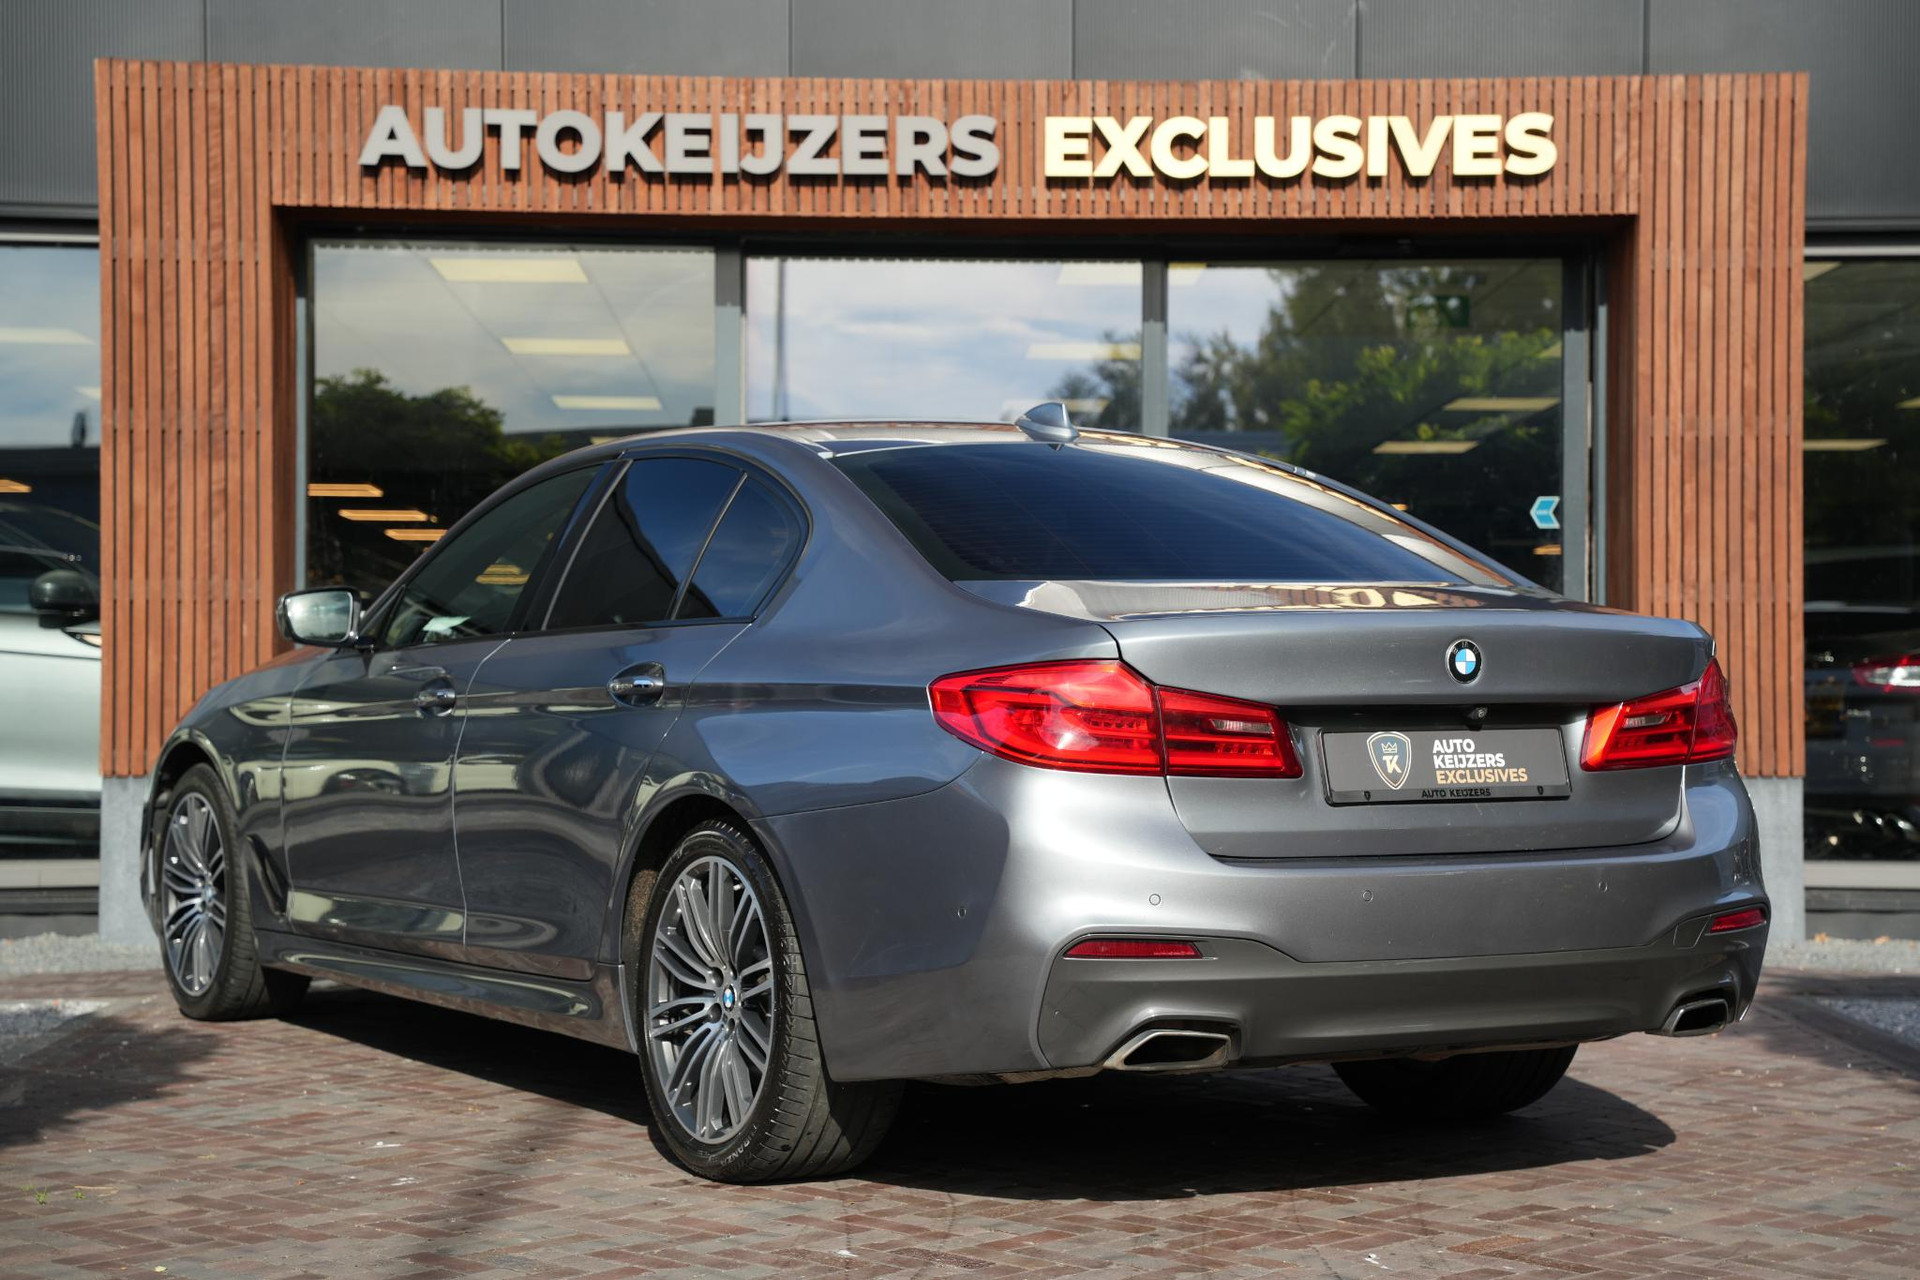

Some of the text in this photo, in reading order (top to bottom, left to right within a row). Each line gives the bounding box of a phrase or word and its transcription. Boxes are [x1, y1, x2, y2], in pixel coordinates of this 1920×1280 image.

[359, 104, 1558, 180] AUTOKEIJZERS EXCLUSIVES
[1432, 738, 1476, 754] AUTO
[1433, 753, 1506, 769] KEIJZERS
[1435, 767, 1529, 785] EXCLUSIVES
[1421, 788, 1492, 799] AUTO KEIJZERS
